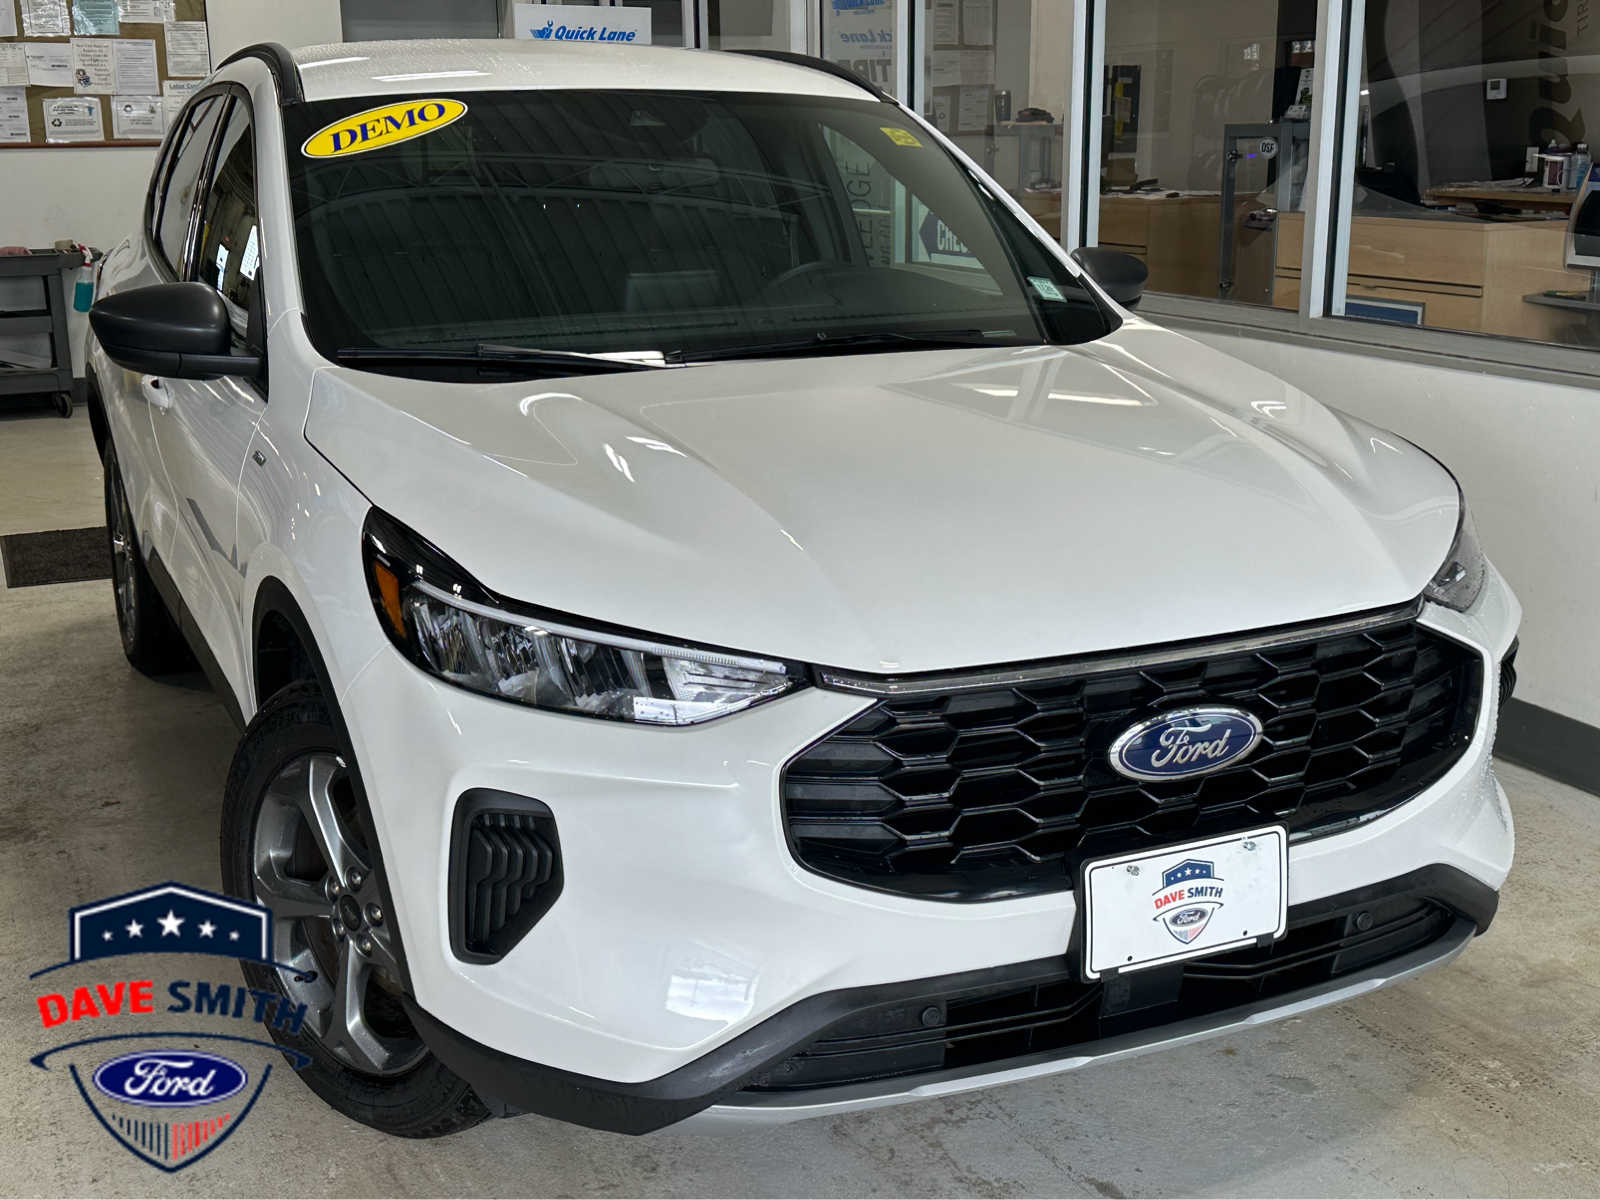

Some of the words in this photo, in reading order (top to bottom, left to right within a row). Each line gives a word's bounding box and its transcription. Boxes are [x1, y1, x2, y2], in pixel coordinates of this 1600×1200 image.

[555, 25, 597, 41] Quick
[598, 27, 636, 42] Lane
[330, 102, 446, 153] DEMO
[1150, 724, 1232, 769] Ford
[1154, 889, 1185, 910] DAVE
[1187, 886, 1223, 899] SMITH
[1176, 910, 1201, 925] Ford
